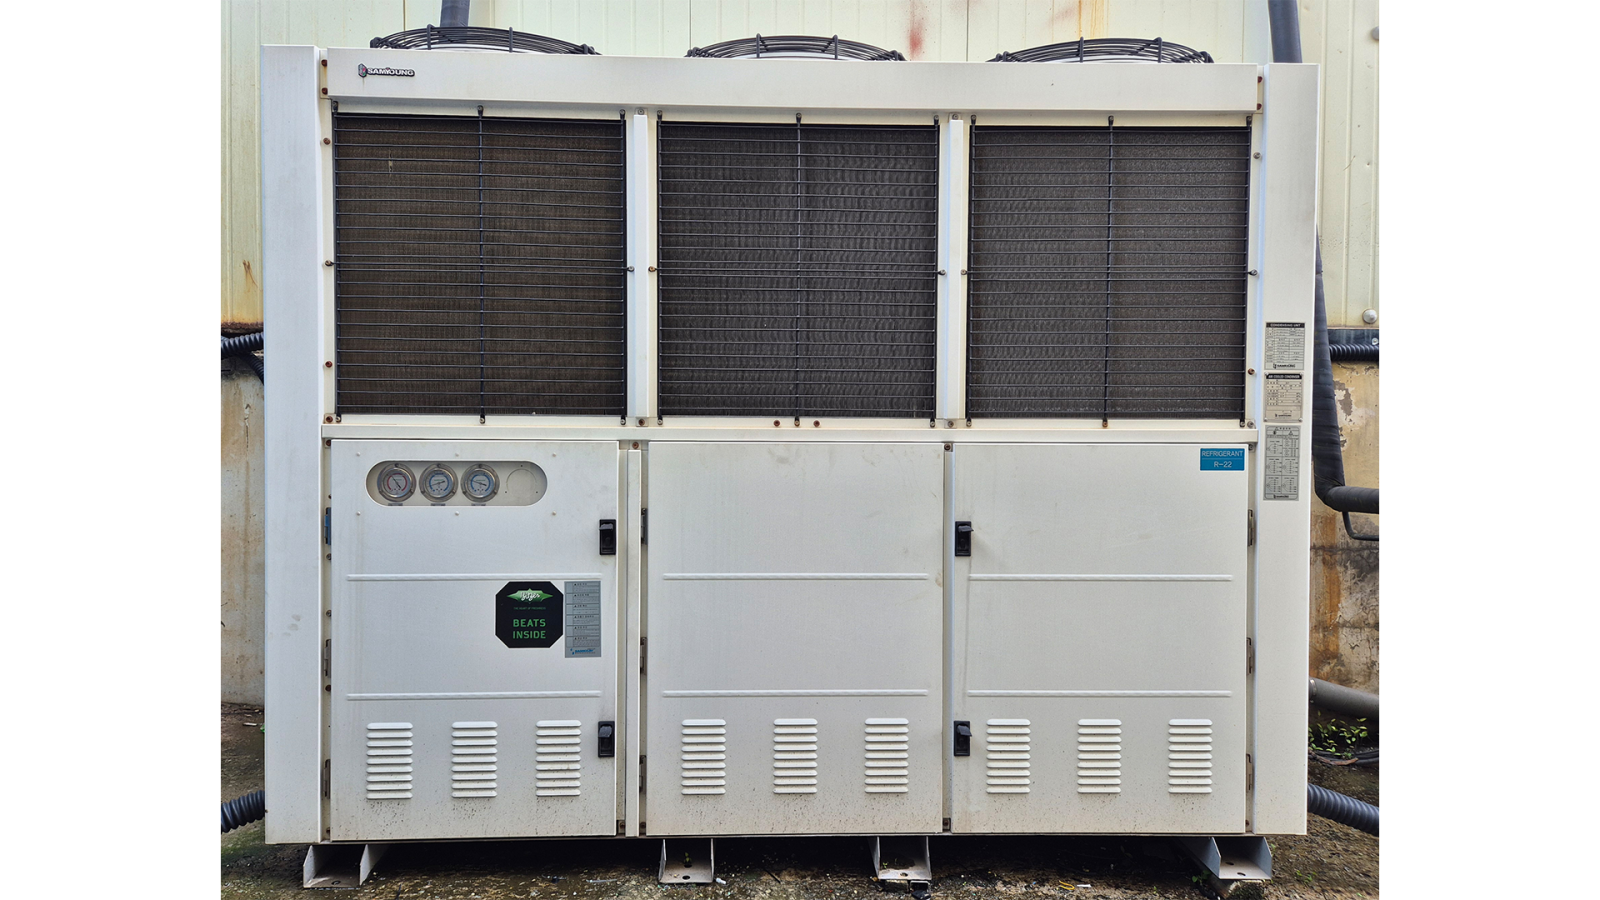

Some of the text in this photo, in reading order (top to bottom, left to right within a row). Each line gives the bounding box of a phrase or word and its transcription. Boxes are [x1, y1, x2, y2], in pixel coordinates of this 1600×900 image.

[367, 68, 414, 76] SAMYOUNG
[512, 618, 546, 628] BEATS
[512, 630, 546, 639] INSIDE
